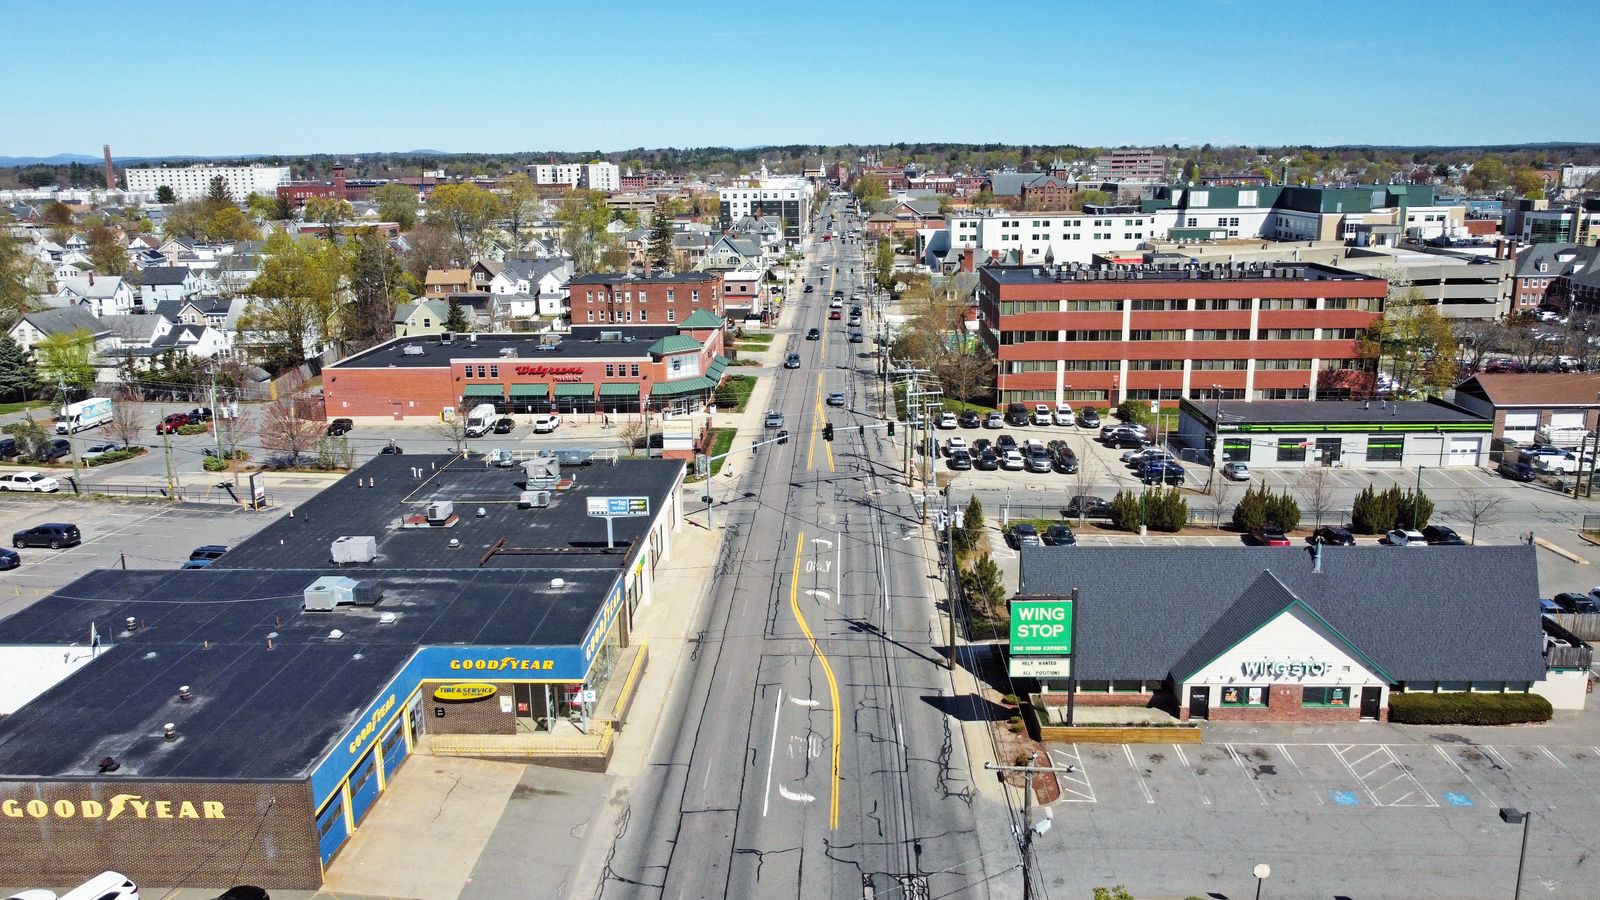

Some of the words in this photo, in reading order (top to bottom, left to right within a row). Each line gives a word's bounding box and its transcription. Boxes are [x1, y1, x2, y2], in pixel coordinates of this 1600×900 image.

[515, 365, 583, 378] Walgreens
[1018, 607, 1065, 621] WING
[1017, 624, 1064, 638] STOP
[449, 657, 555, 672] GOODYEAR
[349, 693, 396, 754] GOODYEAR
[2, 794, 226, 821] GOODYEAR
